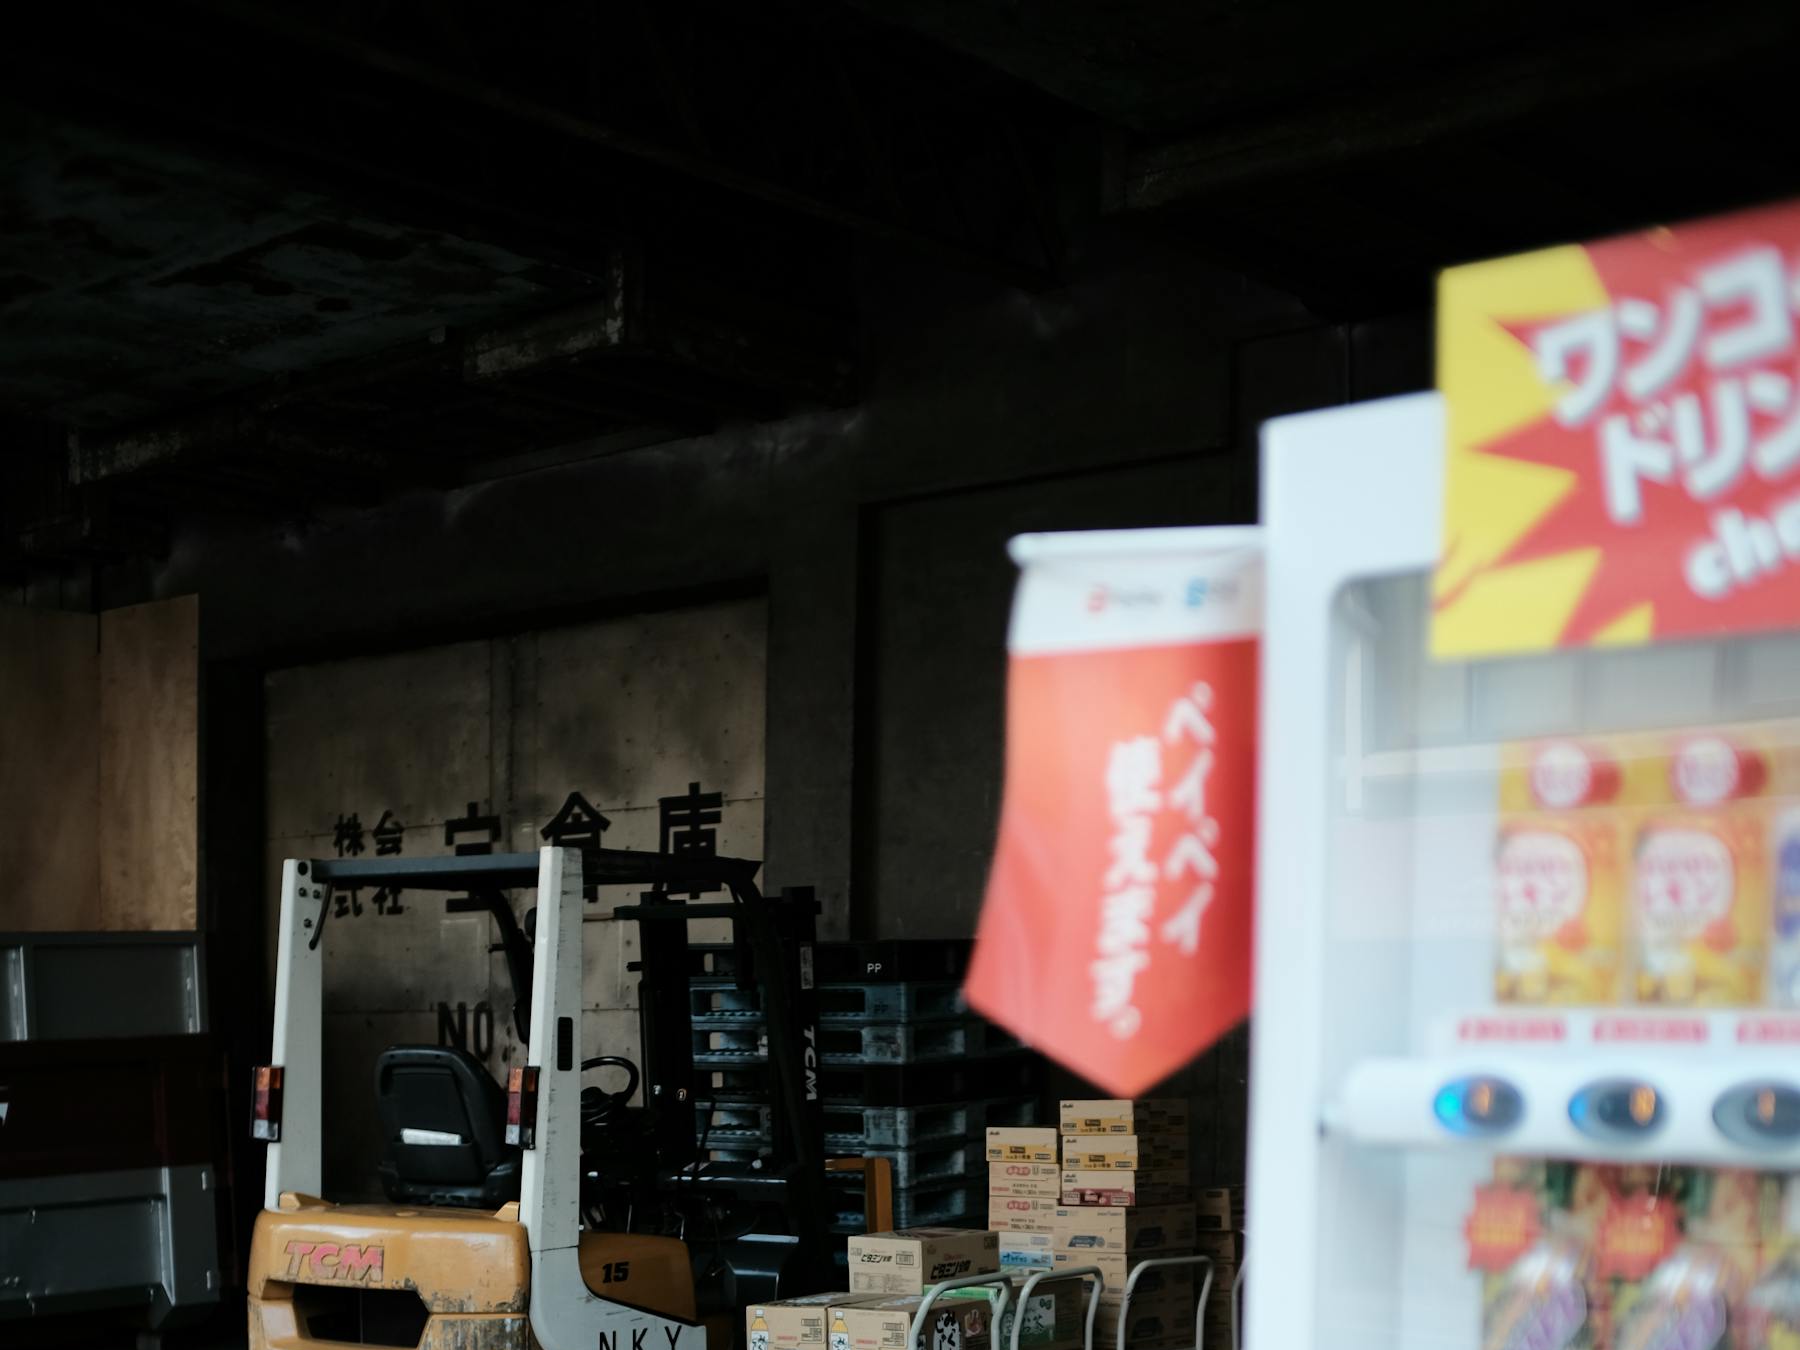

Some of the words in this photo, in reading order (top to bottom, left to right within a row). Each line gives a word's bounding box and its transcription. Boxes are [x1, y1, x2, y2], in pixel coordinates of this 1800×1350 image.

[1532, 245, 1800, 425] ワンコ
[1162, 681, 1220, 956] ペイペイ
[802, 1023, 818, 1102] TCM
[284, 1241, 384, 1282] TCM
[602, 1261, 629, 1283] 15
